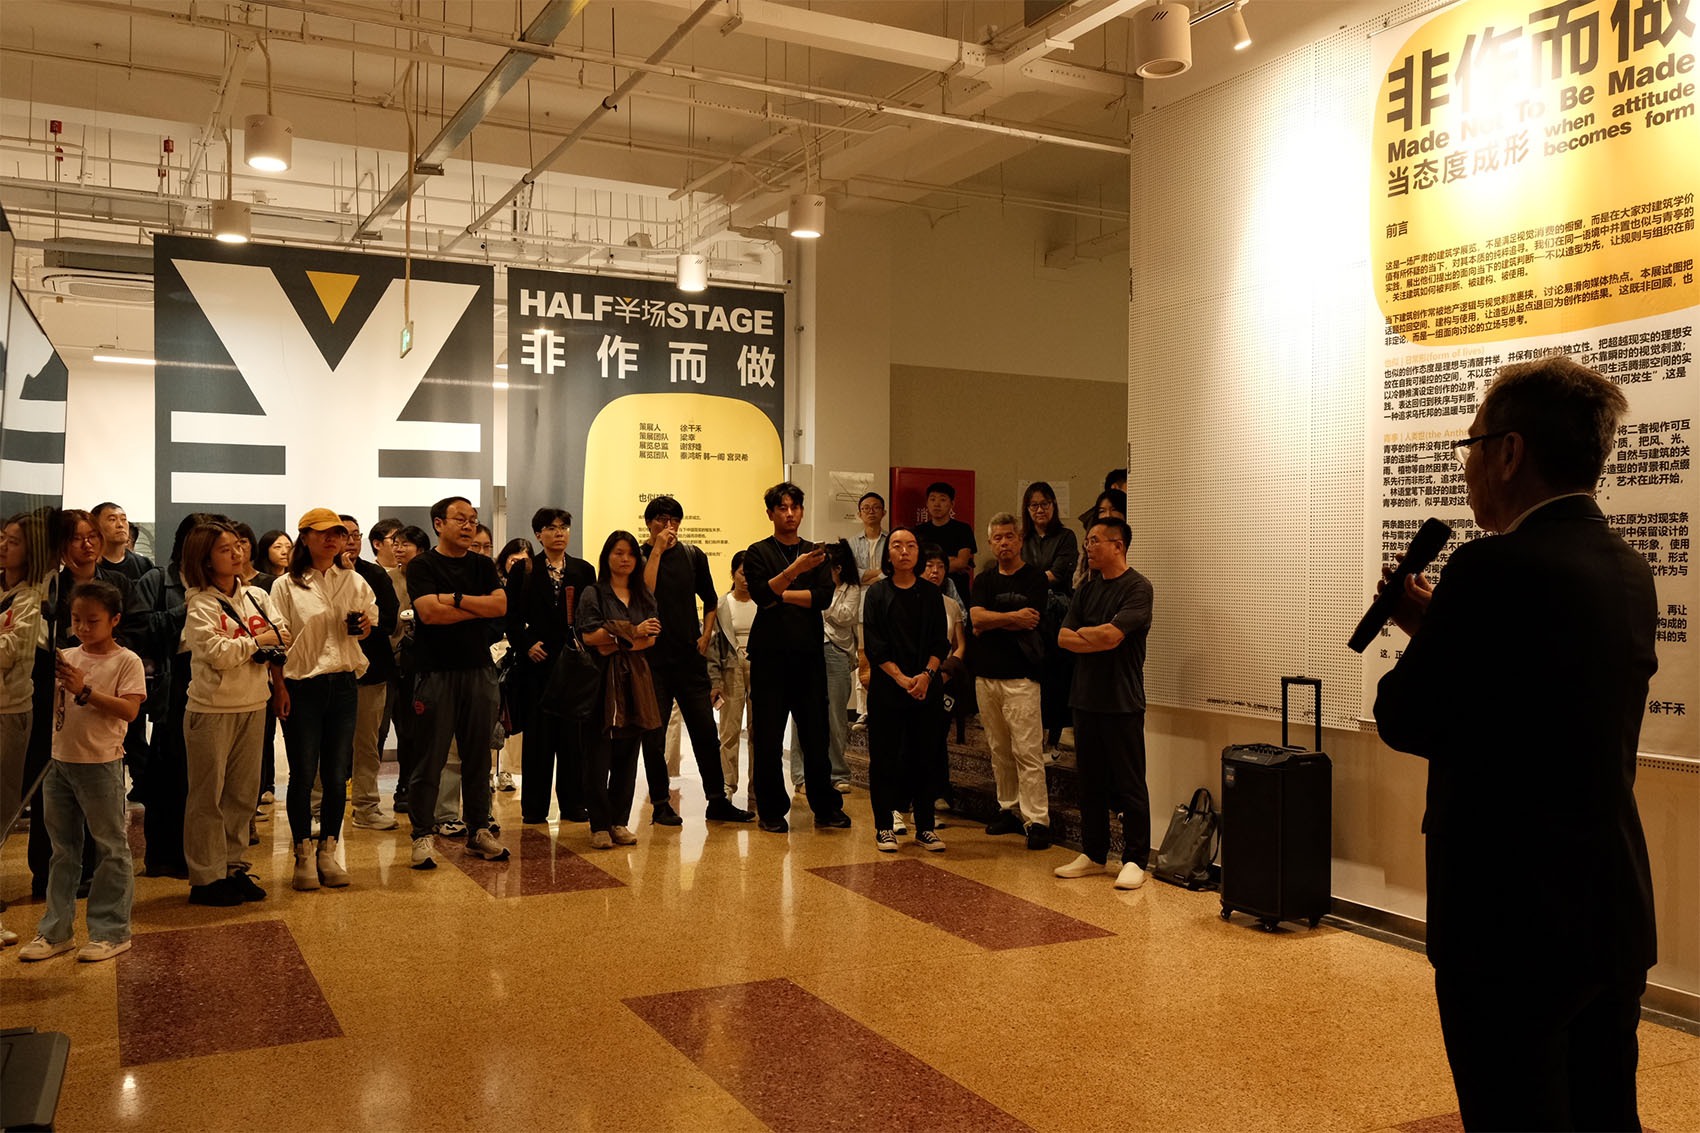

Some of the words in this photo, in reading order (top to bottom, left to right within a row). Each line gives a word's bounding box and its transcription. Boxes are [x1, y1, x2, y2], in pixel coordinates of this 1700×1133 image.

[1388, 129, 1449, 163] Made
[1516, 99, 1546, 122] To
[1560, 84, 1595, 112] Be
[1608, 53, 1696, 96] Made
[1544, 112, 1595, 137] when
[1612, 82, 1695, 118] attitude
[1544, 121, 1632, 157] becomes
[1645, 103, 1695, 129] form
[1387, 129, 1530, 198] 当态度成形
[1386, 220, 1409, 239] 前言
[520, 288, 614, 321] HALF
[667, 302, 774, 335] STAGE
